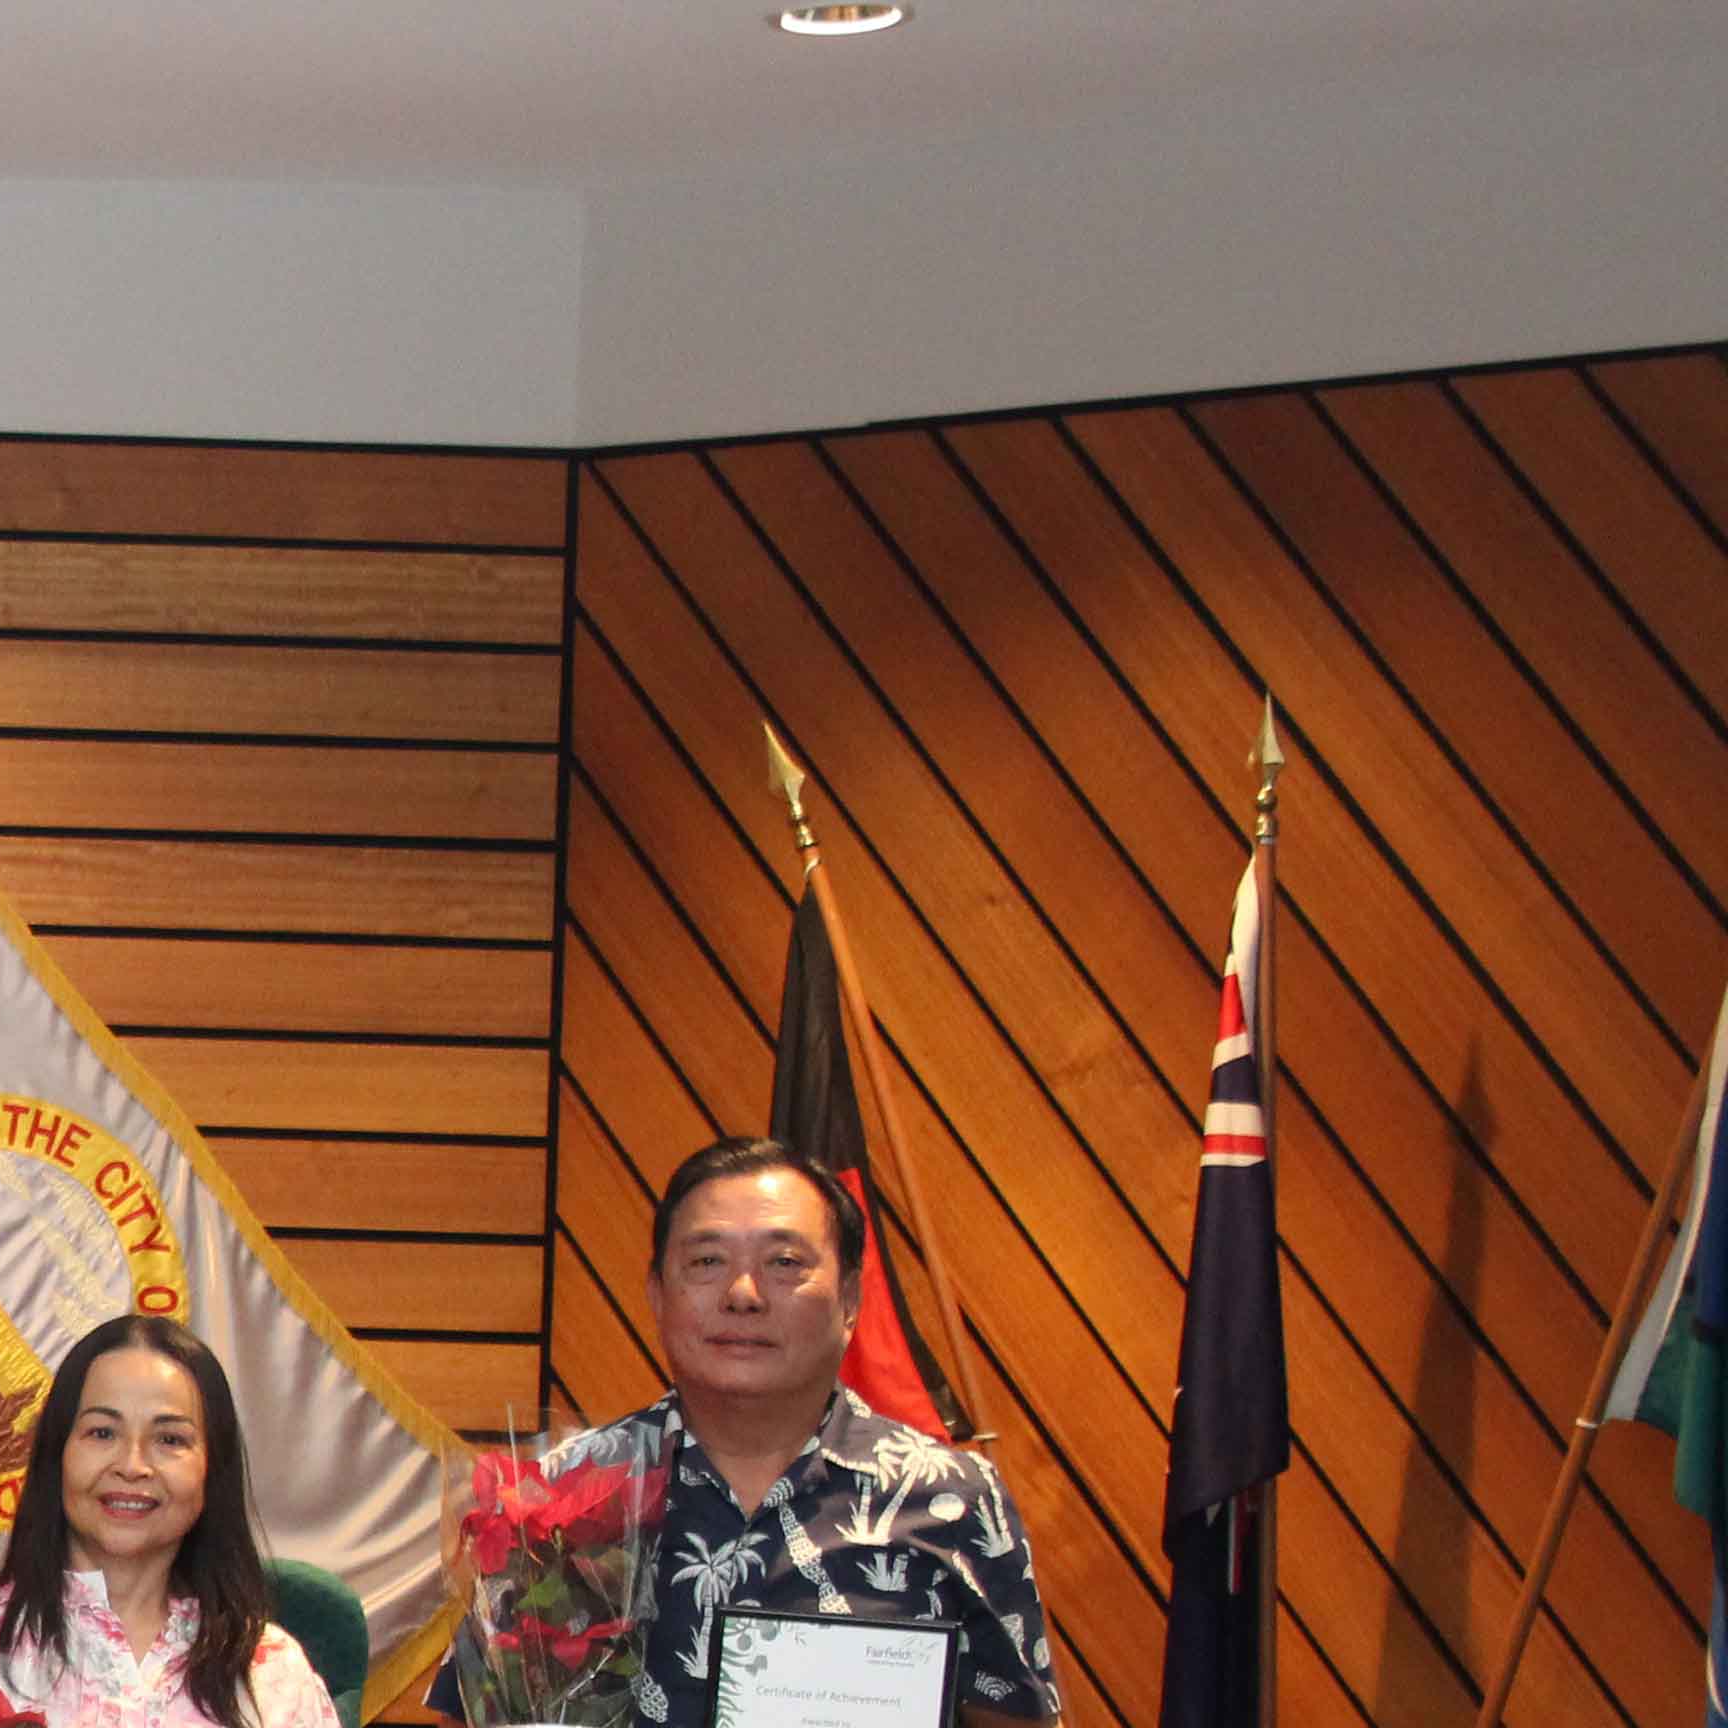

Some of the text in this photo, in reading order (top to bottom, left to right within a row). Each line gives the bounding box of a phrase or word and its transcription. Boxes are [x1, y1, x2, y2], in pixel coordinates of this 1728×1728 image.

[2, 1104, 92, 1168] THE
[95, 1161, 171, 1254] CITY
[137, 1285, 179, 1315] O
[755, 1686, 902, 1706] Certificate of Achievement
